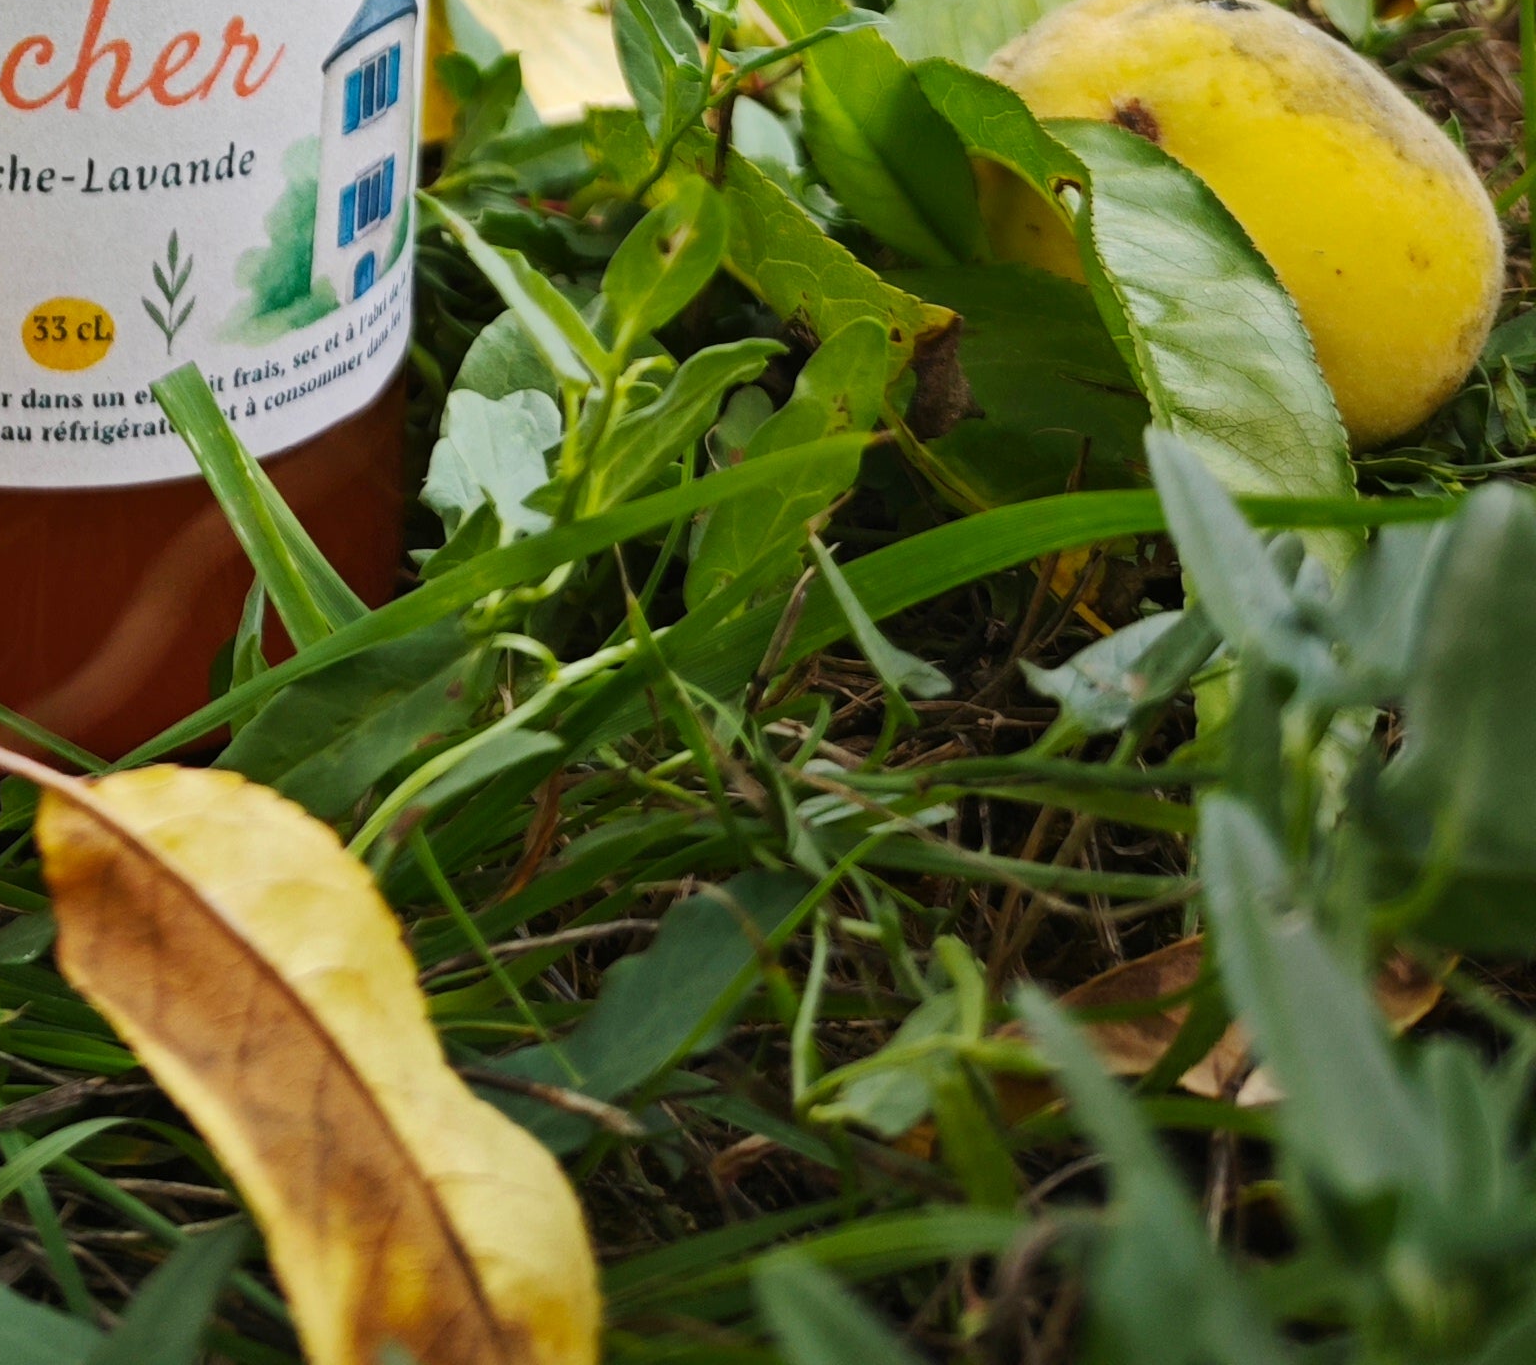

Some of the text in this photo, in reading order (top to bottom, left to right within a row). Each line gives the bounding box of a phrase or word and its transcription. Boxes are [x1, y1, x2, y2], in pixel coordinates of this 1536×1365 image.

[21, 388, 83, 408] dans
[93, 391, 125, 407] un
[233, 358, 286, 388] frais,
[293, 345, 320, 369] sec
[325, 331, 340, 353] et
[345, 322, 355, 343] à
[33, 314, 114, 343] 33 cL
[1, 424, 32, 441] au
[41, 418, 176, 445] réfrigérat
[245, 396, 257, 417] à
[264, 350, 364, 412] consommer
